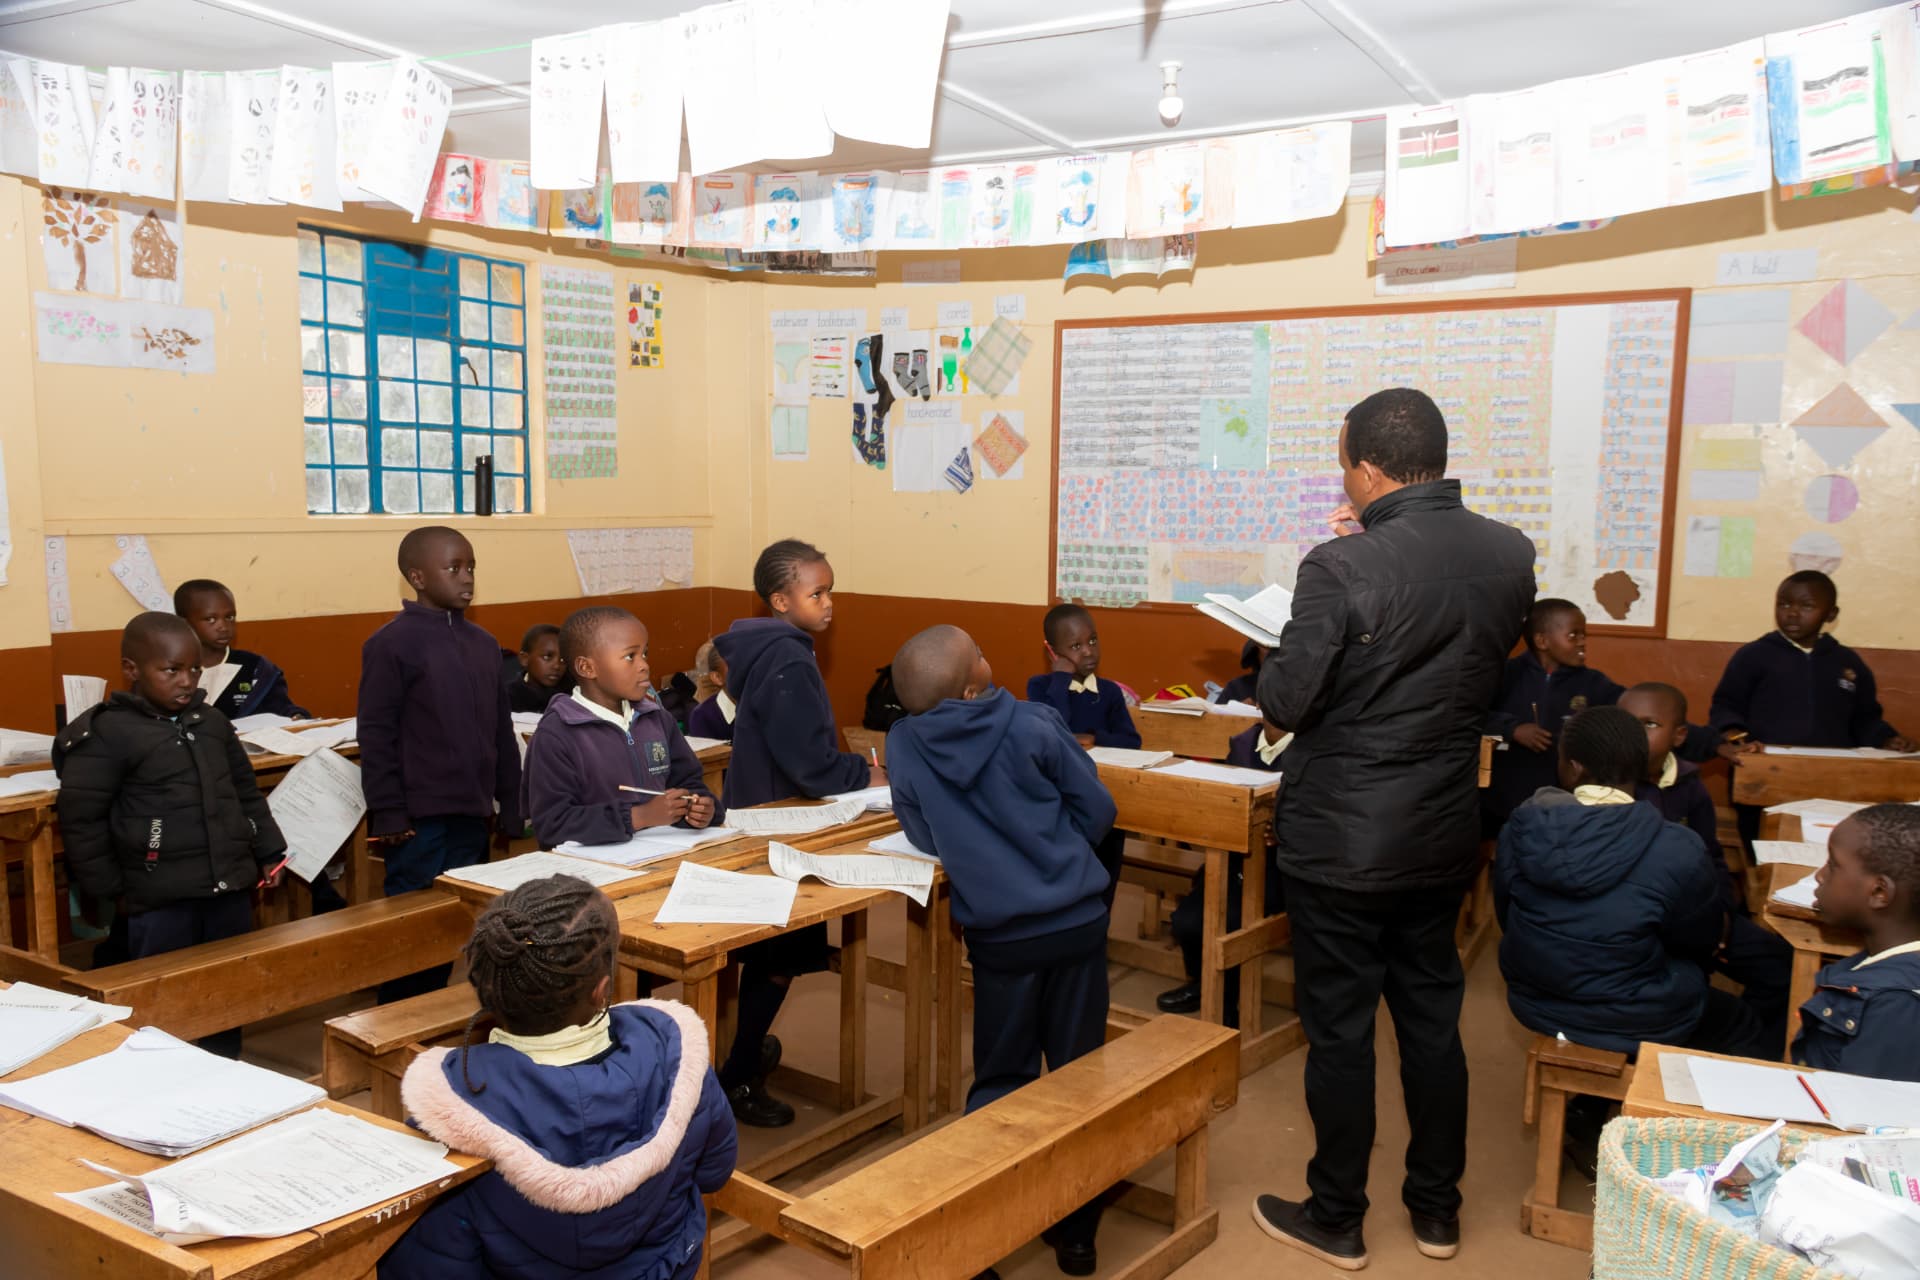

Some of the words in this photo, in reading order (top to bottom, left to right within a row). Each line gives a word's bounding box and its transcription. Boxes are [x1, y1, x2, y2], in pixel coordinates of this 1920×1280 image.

[1727, 256, 1742, 275] A
[1751, 255, 1780, 275] half
[149, 818, 163, 849] SNOW
